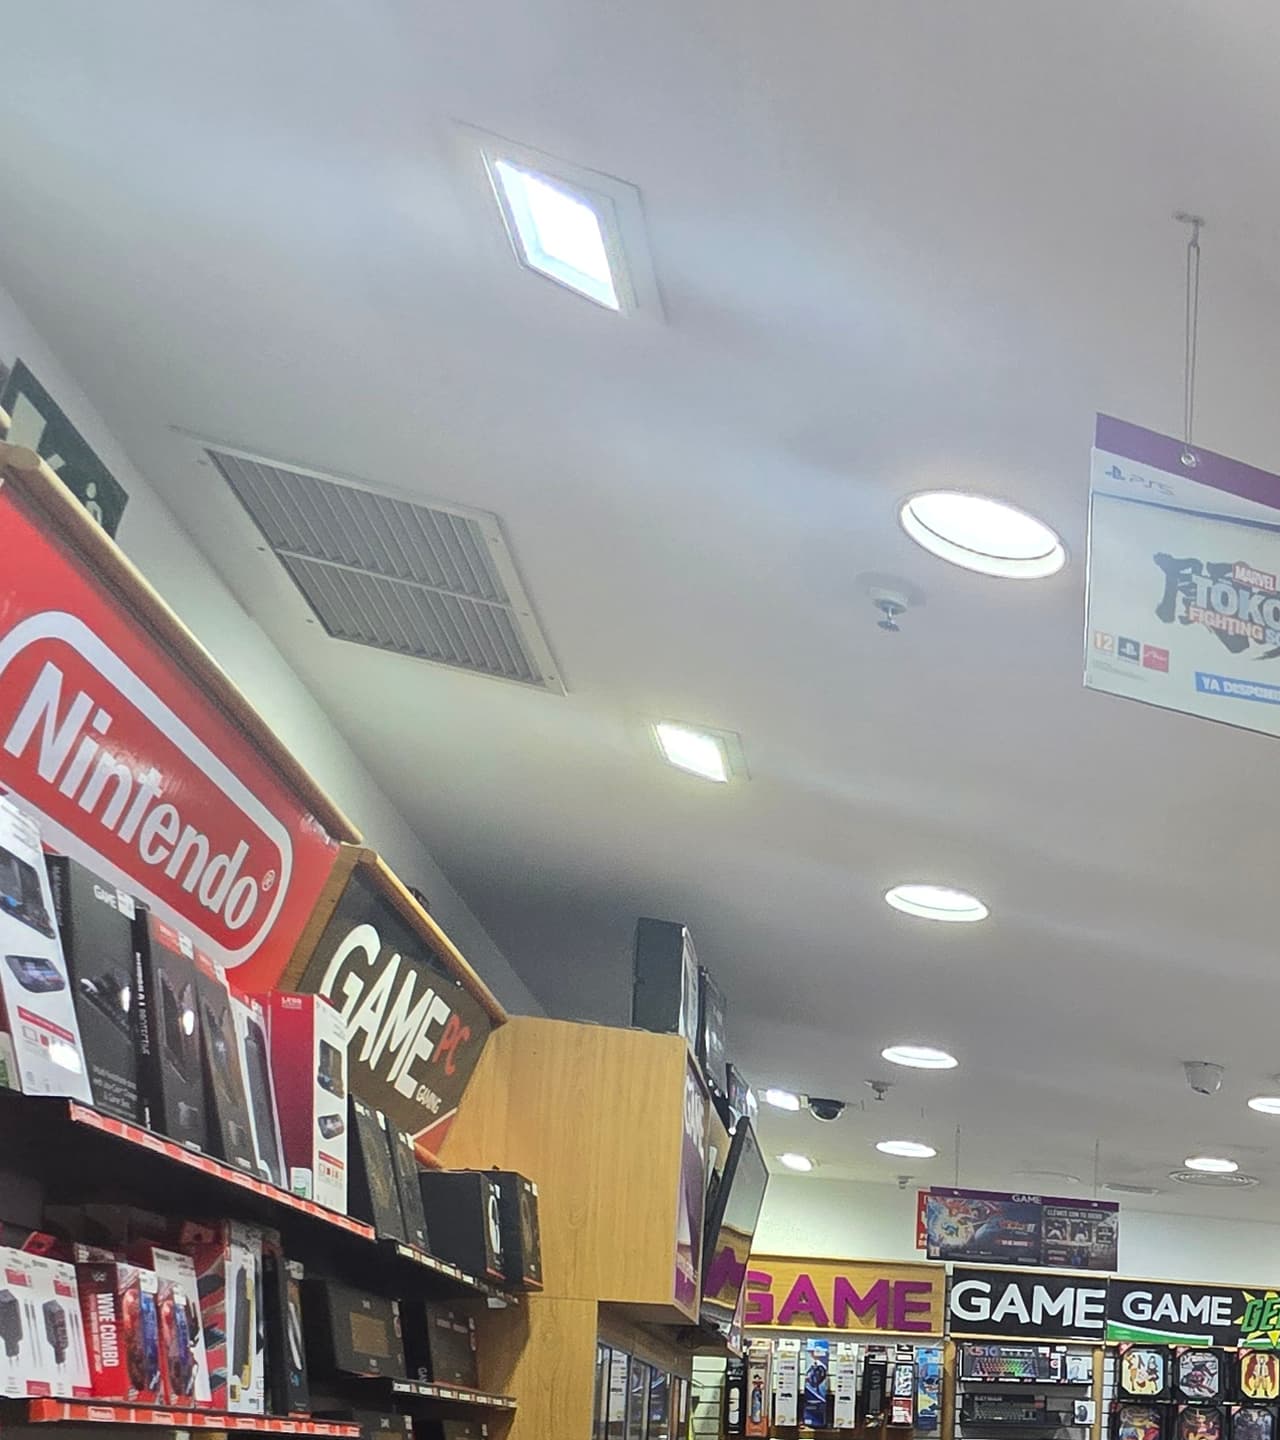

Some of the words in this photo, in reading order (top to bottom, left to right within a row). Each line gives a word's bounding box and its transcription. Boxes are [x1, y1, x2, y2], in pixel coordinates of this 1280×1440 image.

[1235, 566, 1275, 590] MARVEL
[1189, 606, 1263, 639] FIGHTING
[1095, 632, 1112, 649] 12
[1203, 676, 1220, 691] YA
[3, 661, 258, 930] Nintendo
[322, 923, 451, 1098] GAME
[433, 1014, 470, 1074] PC
[416, 1084, 441, 1113] GAMING
[1012, 1195, 1041, 1204] GAME
[745, 1270, 932, 1332] GAME
[950, 1280, 1107, 1329] GAME
[1122, 1291, 1232, 1325] GAME
